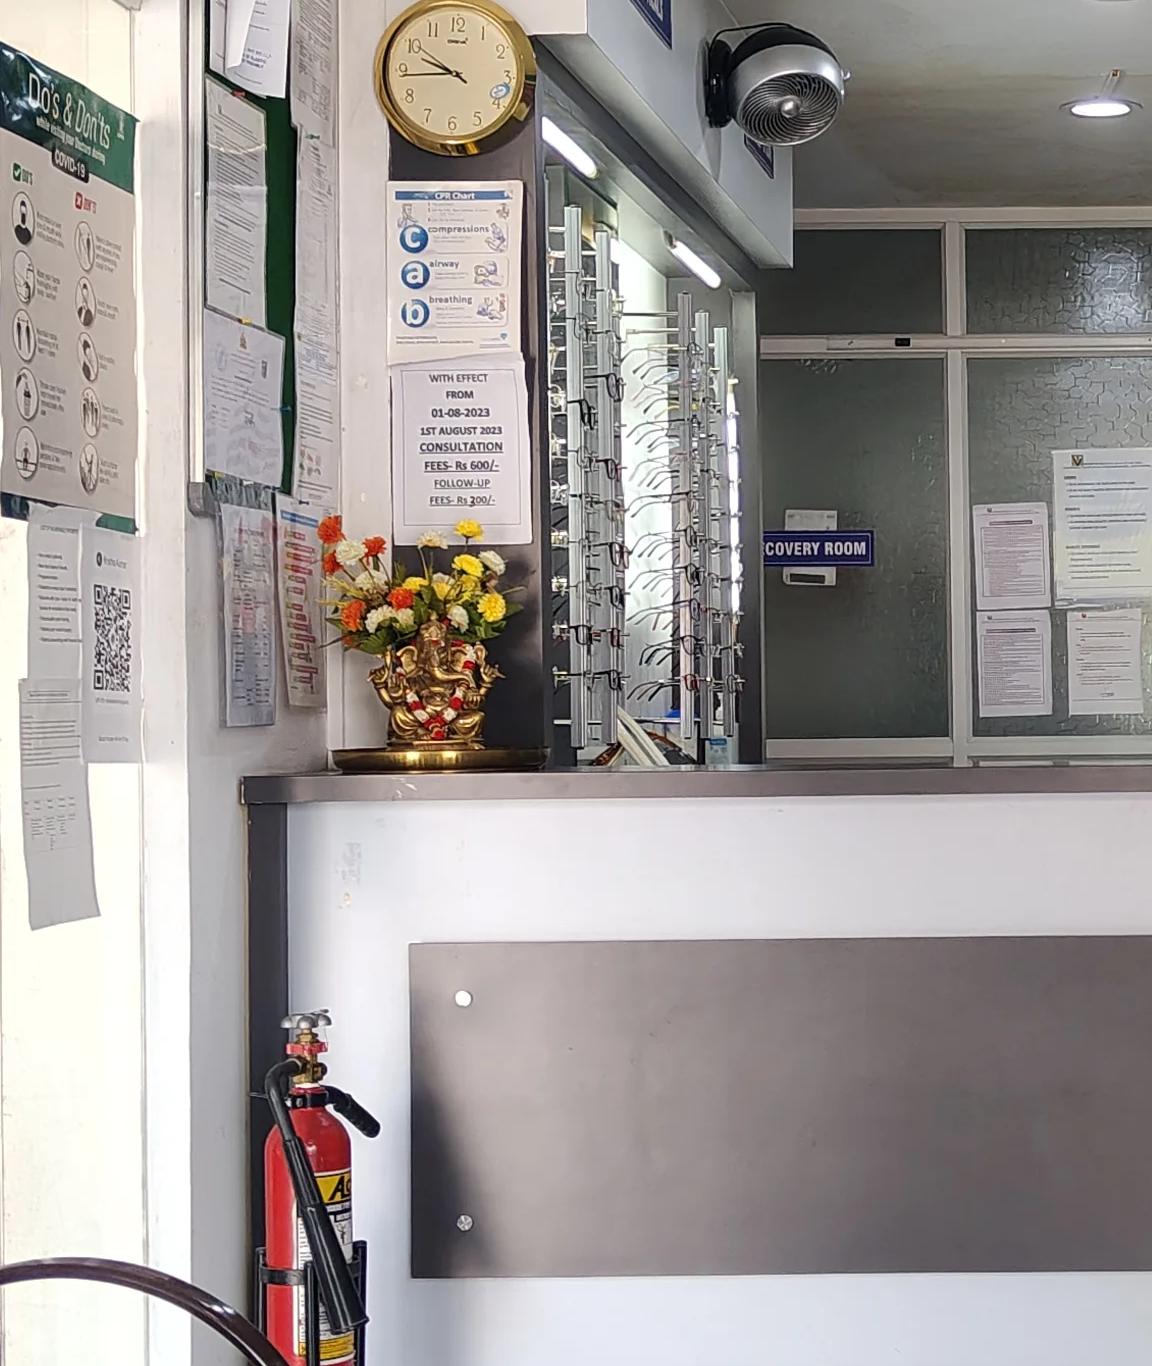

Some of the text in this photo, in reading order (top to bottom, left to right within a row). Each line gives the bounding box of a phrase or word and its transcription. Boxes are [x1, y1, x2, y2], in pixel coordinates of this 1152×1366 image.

[428, 22, 438, 37] 11
[451, 17, 465, 32] 12
[482, 26, 485, 40] 1
[408, 39, 421, 53] 10
[496, 44, 505, 59] 2
[399, 63, 407, 77] 9
[504, 71, 512, 83] 3
[405, 89, 414, 103] 8
[28, 73, 110, 149] Do's & Don'ts
[424, 109, 432, 123] 7
[448, 116, 457, 130] 6
[473, 112, 482, 126] 5
[55, 149, 85, 177] COVID-19
[434, 192, 451, 200] CPR
[428, 226, 489, 234] compressions
[429, 260, 459, 269] airway
[429, 296, 472, 304] breathing
[429, 374, 488, 383] WITH EFFECT
[446, 391, 474, 399] FROM
[431, 409, 490, 418] 01-08-2023
[420, 426, 502, 435] 1ST AUGUST 2023
[420, 442, 503, 452] CONSULTATION
[424, 460, 499, 471] FEES- Rs 600/-
[434, 479, 491, 487] FOLLOW-UP
[430, 496, 454, 504] FEES-
[457, 496, 467, 504] Rs
[763, 542, 866, 556] COVERY ROOM
